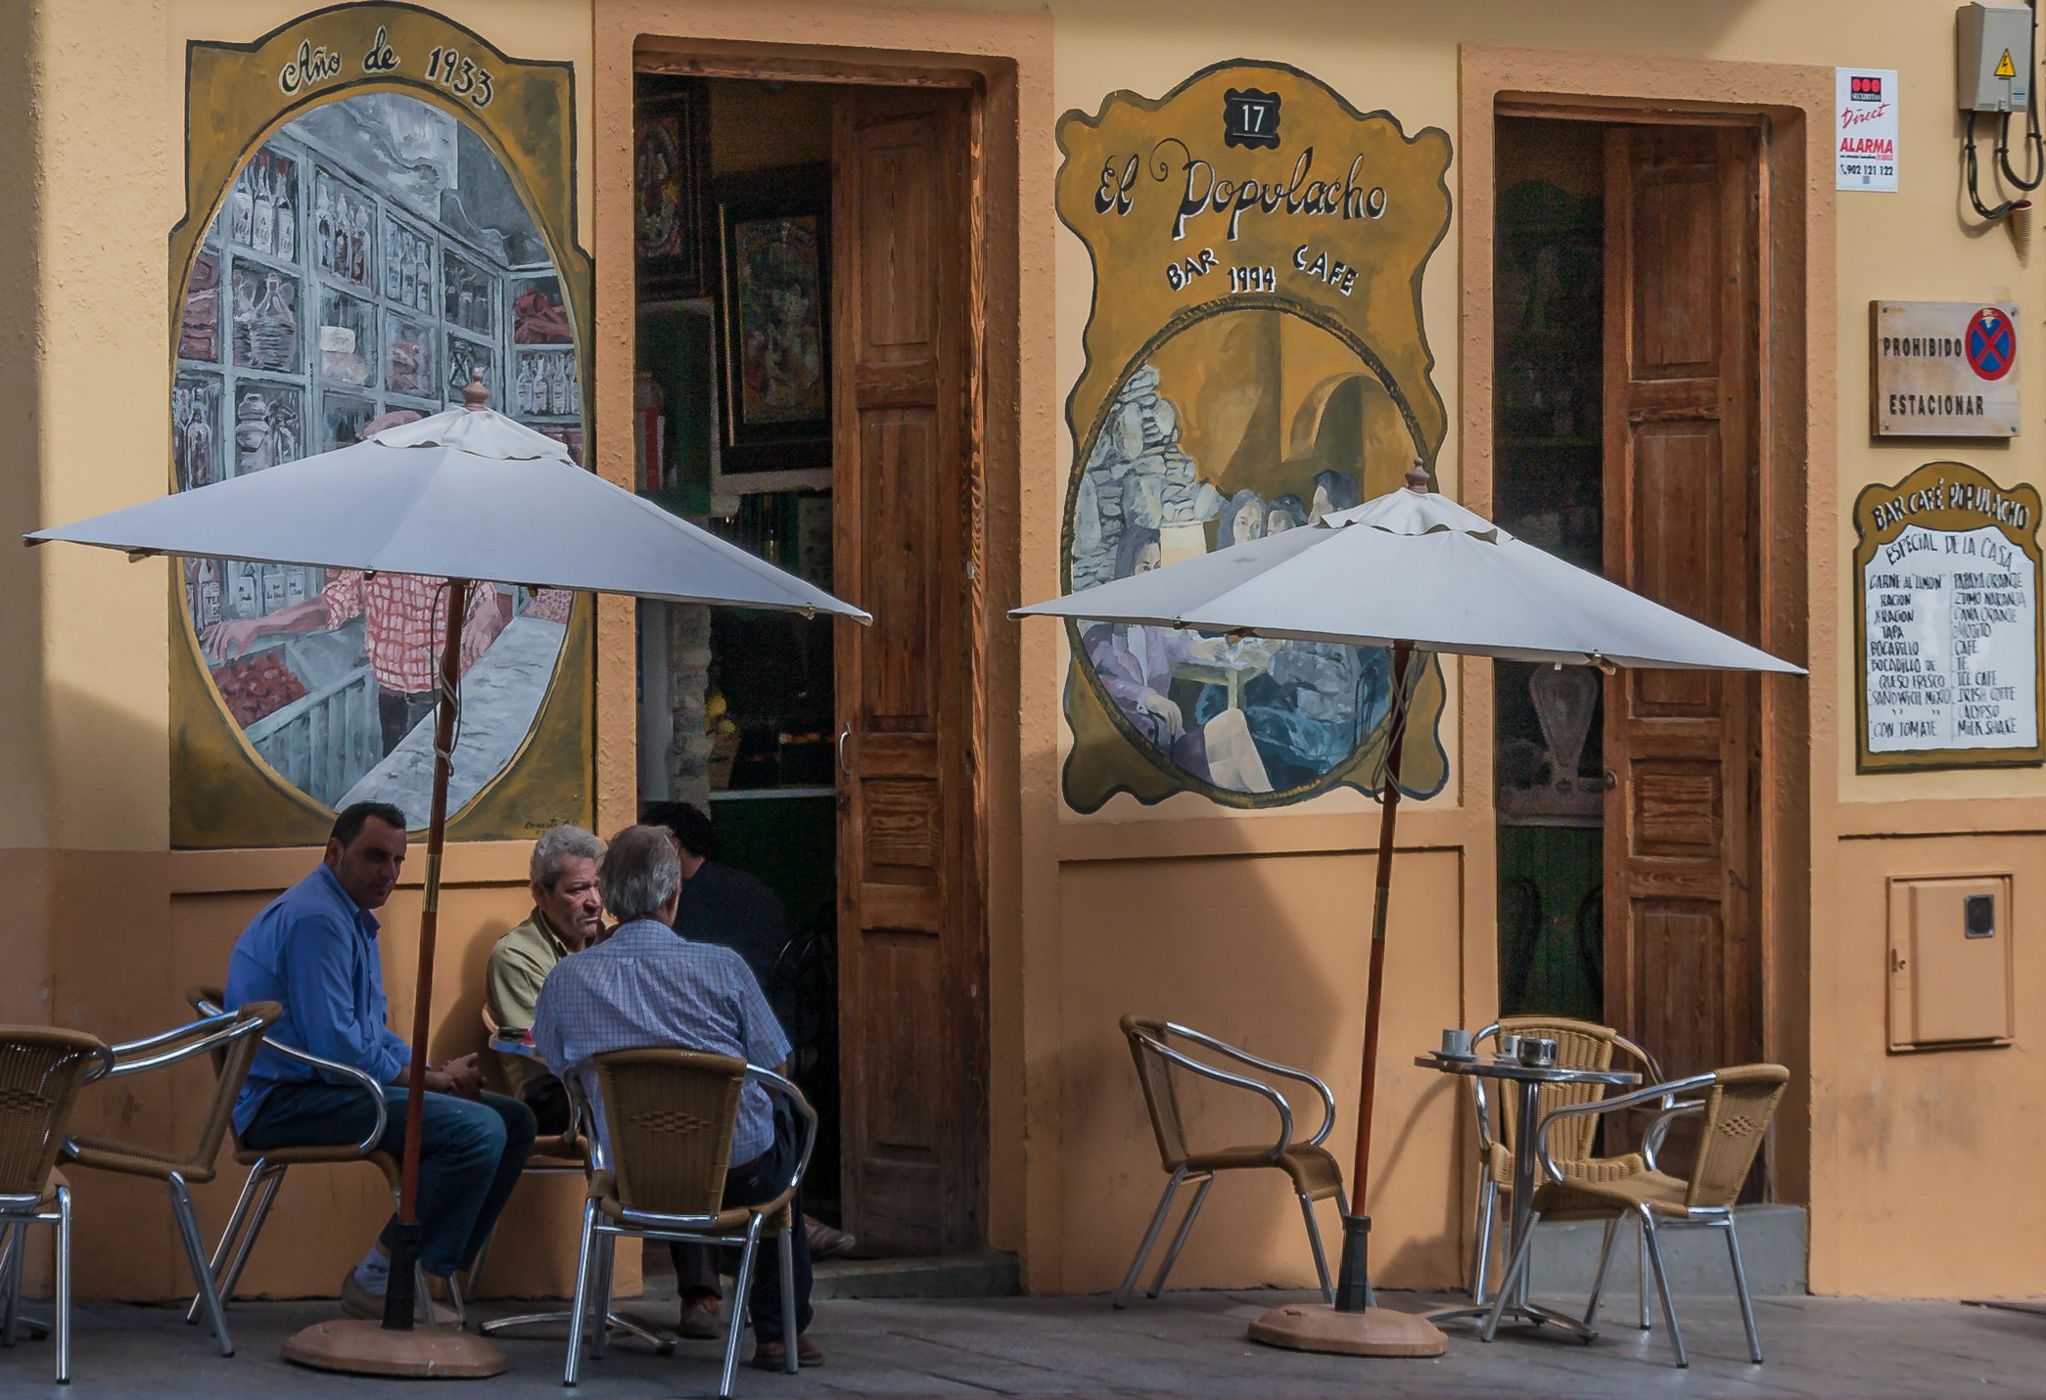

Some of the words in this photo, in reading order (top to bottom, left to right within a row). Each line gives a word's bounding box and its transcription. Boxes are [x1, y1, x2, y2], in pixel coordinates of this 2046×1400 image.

[279, 38, 342, 96] Año
[362, 24, 401, 73] de
[425, 45, 495, 109] 1933
[1241, 103, 1266, 134] 17
[1841, 102, 1890, 129] Direct
[1840, 137, 1893, 154] ALARMA
[1847, 164, 1862, 175] 902
[1864, 165, 1877, 175] 121
[1880, 165, 1893, 176] 122
[1095, 153, 1140, 216] El
[1149, 137, 1388, 242] Populacho
[1166, 246, 1220, 292] BAR
[1227, 265, 1278, 294] 1994
[1293, 243, 1360, 297] CAFE
[1883, 337, 1962, 357] PROHIBIDO
[1889, 394, 1984, 416] ESTACIONAR
[1872, 495, 1908, 532] BAR
[1949, 482, 2030, 530] POPULACHO
[1885, 533, 1938, 566] ESPECIAL
[1945, 535, 1959, 555] DE
[1963, 536, 1976, 556] LA
[1981, 537, 2013, 572] CASA
[1870, 573, 1900, 590] CARNE
[1870, 640, 1919, 656] BOCADILLO
[1871, 658, 1921, 673] BOCADILLO
[1879, 674, 1910, 689] QUESO
[1912, 674, 1946, 689] FRESCO
[1873, 721, 1894, 738] CON
[1900, 720, 1938, 738] TOMATE
